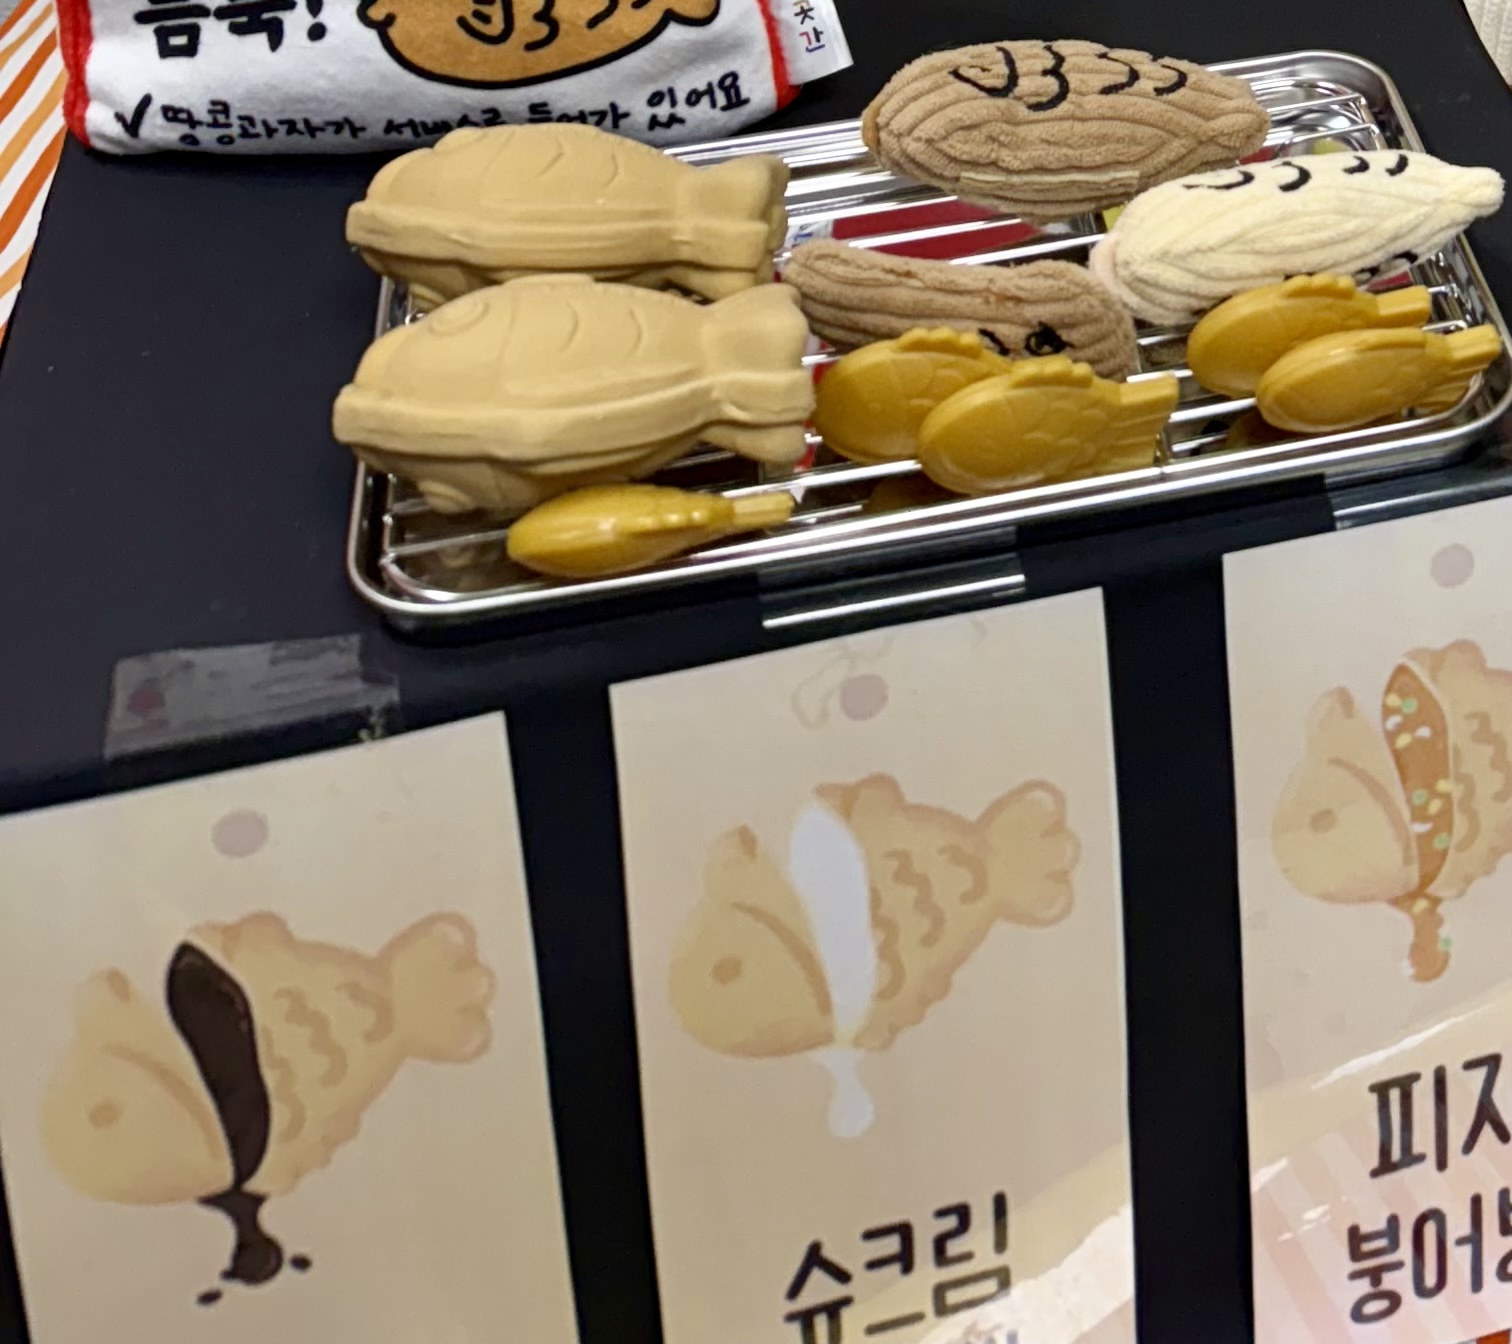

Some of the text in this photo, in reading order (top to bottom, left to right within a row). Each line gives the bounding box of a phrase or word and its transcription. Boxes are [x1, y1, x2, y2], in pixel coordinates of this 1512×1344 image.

[160, 99, 366, 146] 땅콩과자가
[647, 70, 750, 131] 있어요
[784, 1190, 1012, 1344] 슈크림
